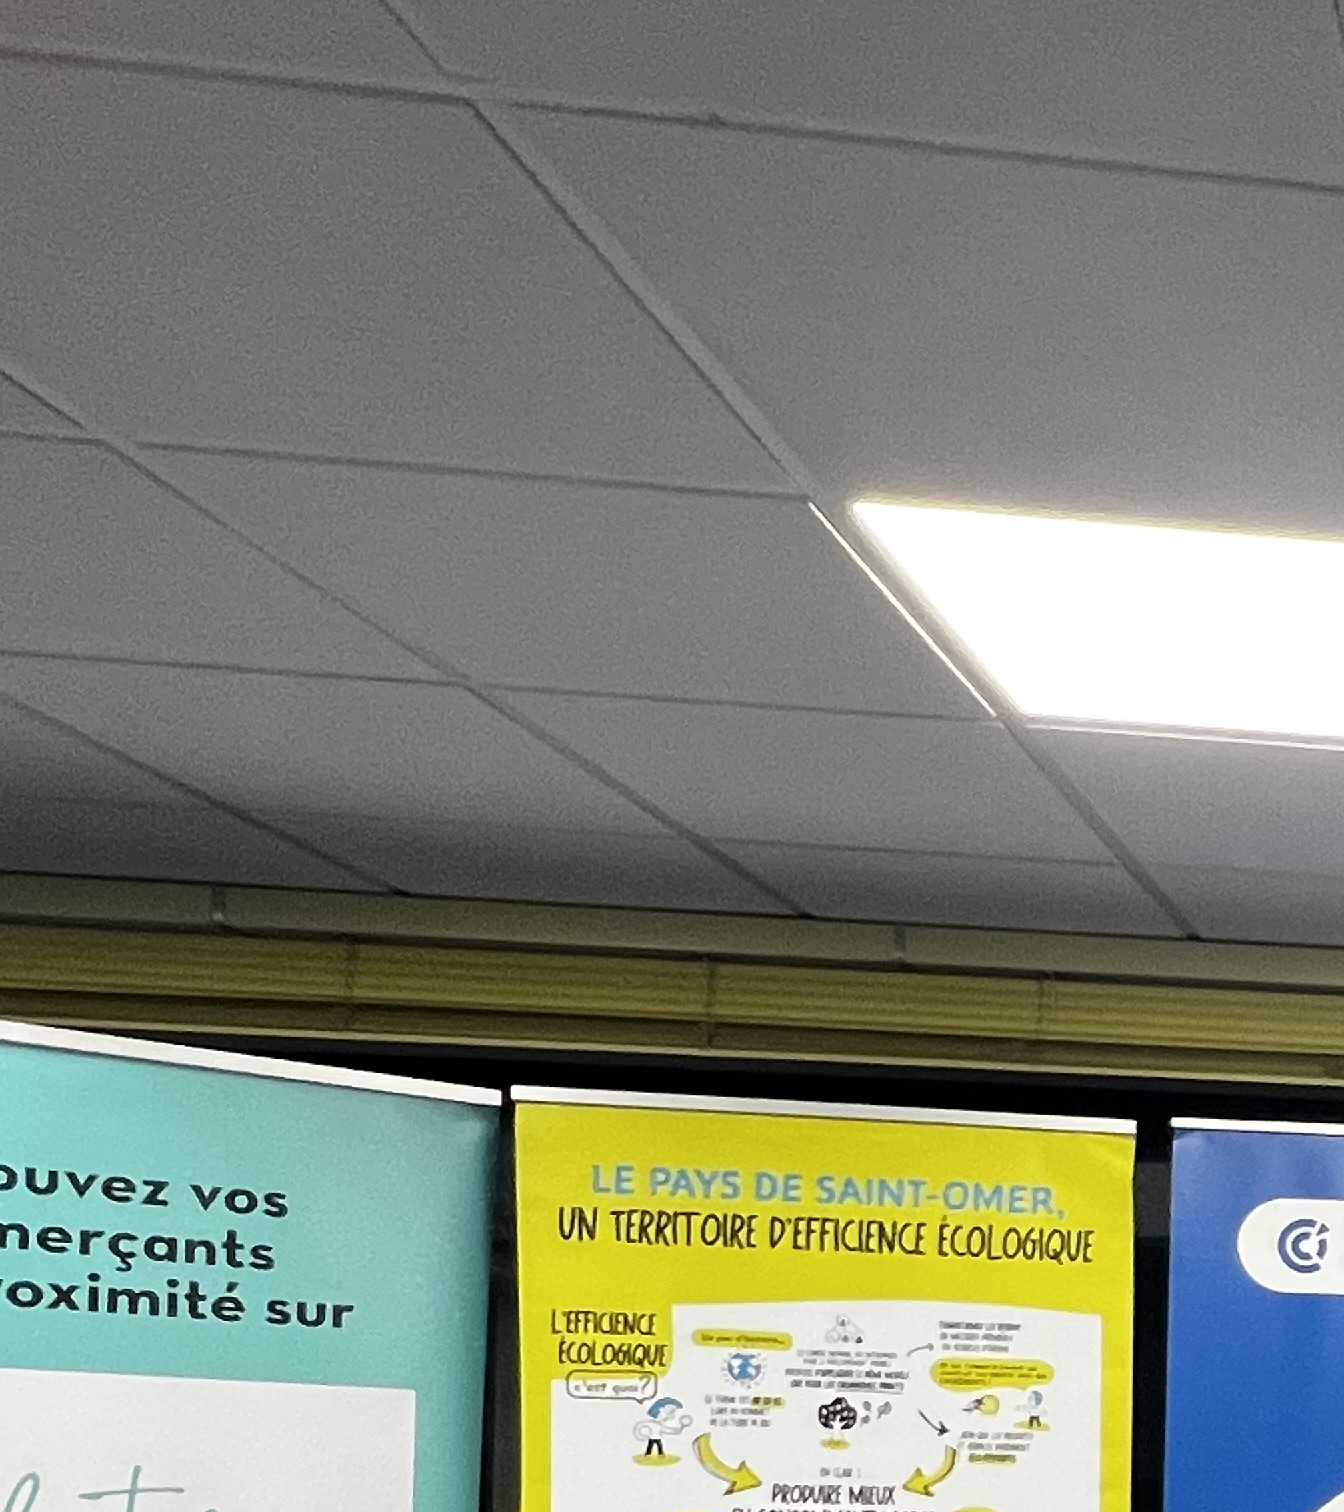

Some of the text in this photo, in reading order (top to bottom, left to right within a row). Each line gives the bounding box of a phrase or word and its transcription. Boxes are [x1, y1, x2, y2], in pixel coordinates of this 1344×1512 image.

[190, 1183, 288, 1218] vos
[591, 1165, 1065, 1220] LE PAYS DE SAINT-OMER,
[558, 1206, 1095, 1265] UN TERRITOIRE D'EFFICIENCE ÉCOLOGIQUE
[0, 1272, 354, 1328] oximité sur
[551, 1309, 657, 1335] L'EFFICIENCE
[558, 1336, 668, 1368] ÉCOLOGIQUE
[771, 1483, 896, 1506] PRODUIRE MIEUX
